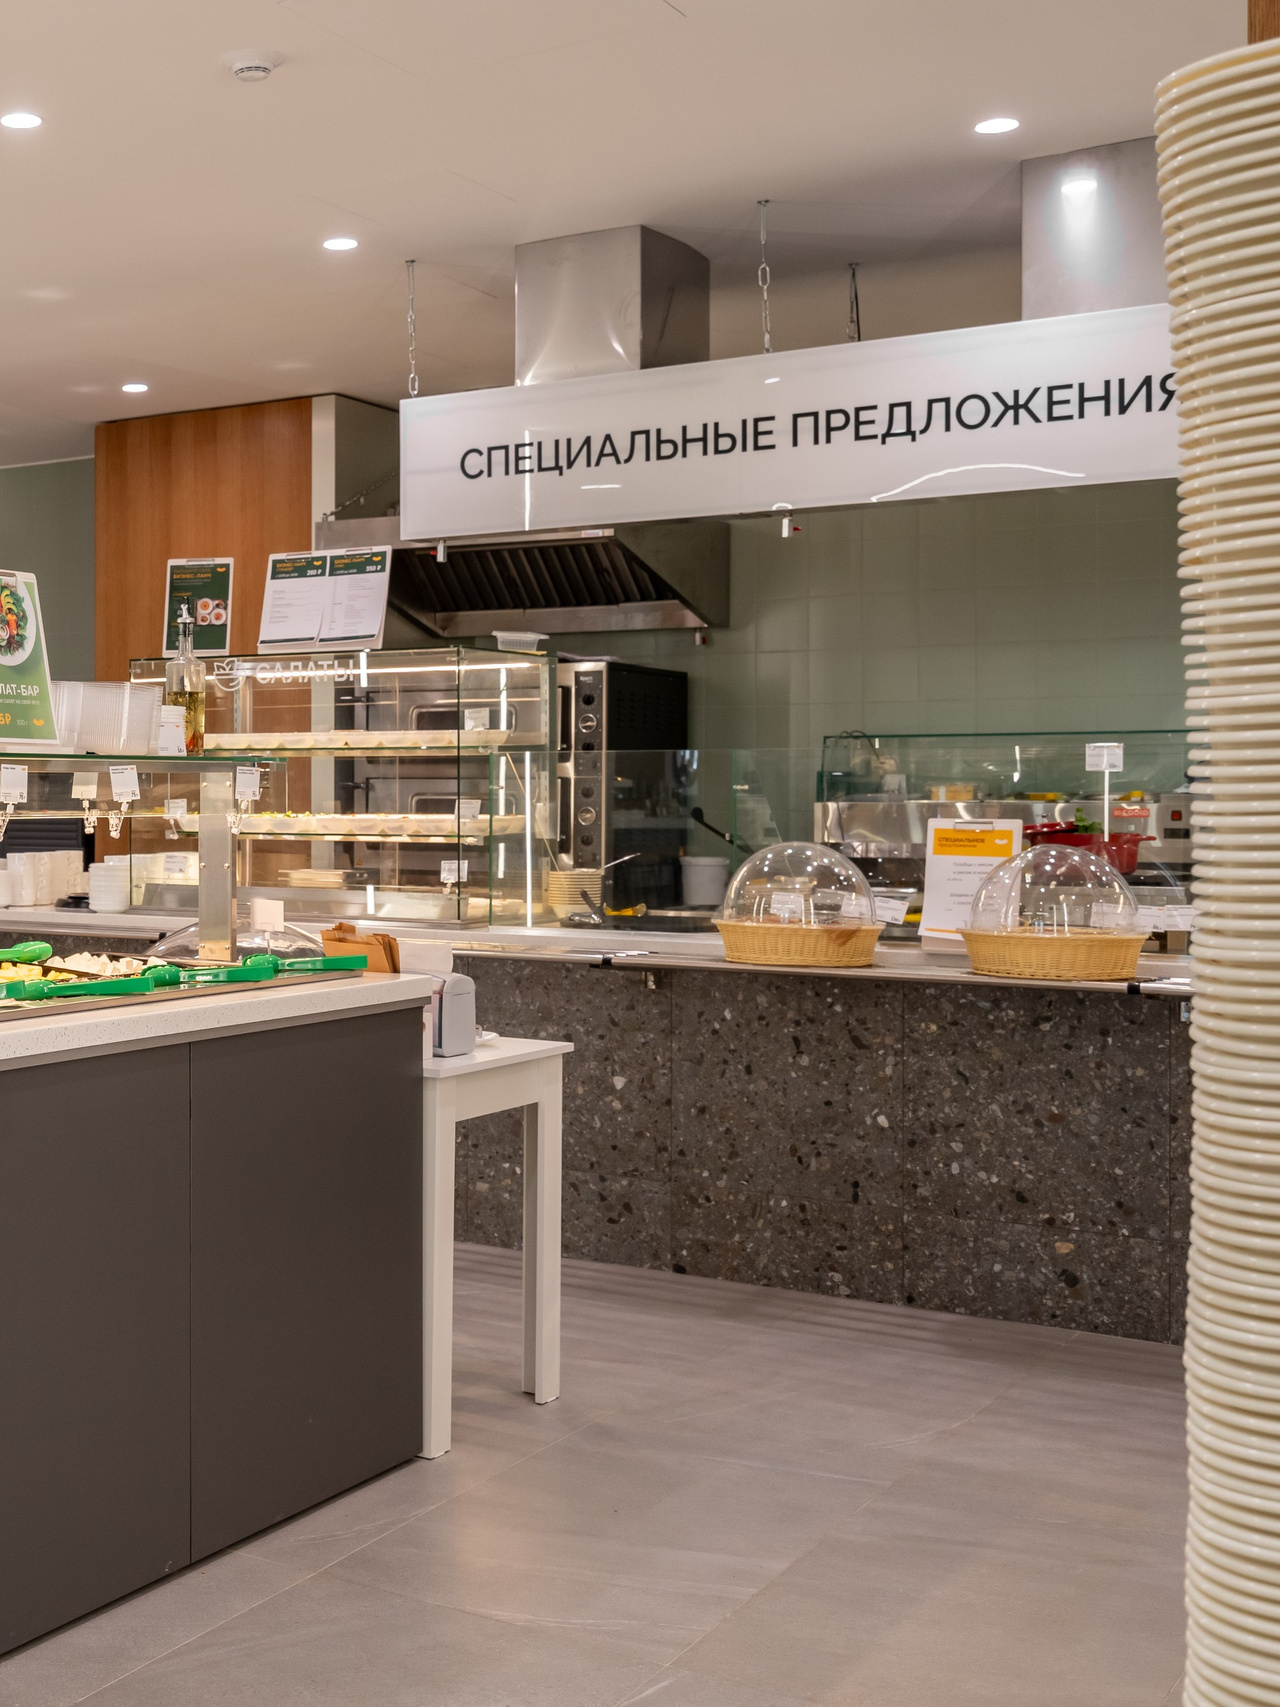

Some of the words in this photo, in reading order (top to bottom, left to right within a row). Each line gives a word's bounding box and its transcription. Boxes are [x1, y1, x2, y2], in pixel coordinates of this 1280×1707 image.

[459, 414, 776, 481] СПЕЦИАЛЬНЫЕ
[255, 659, 354, 684] САЛАТЫ
[937, 836, 986, 844] СПЕЦИАЛЬНОЕ
